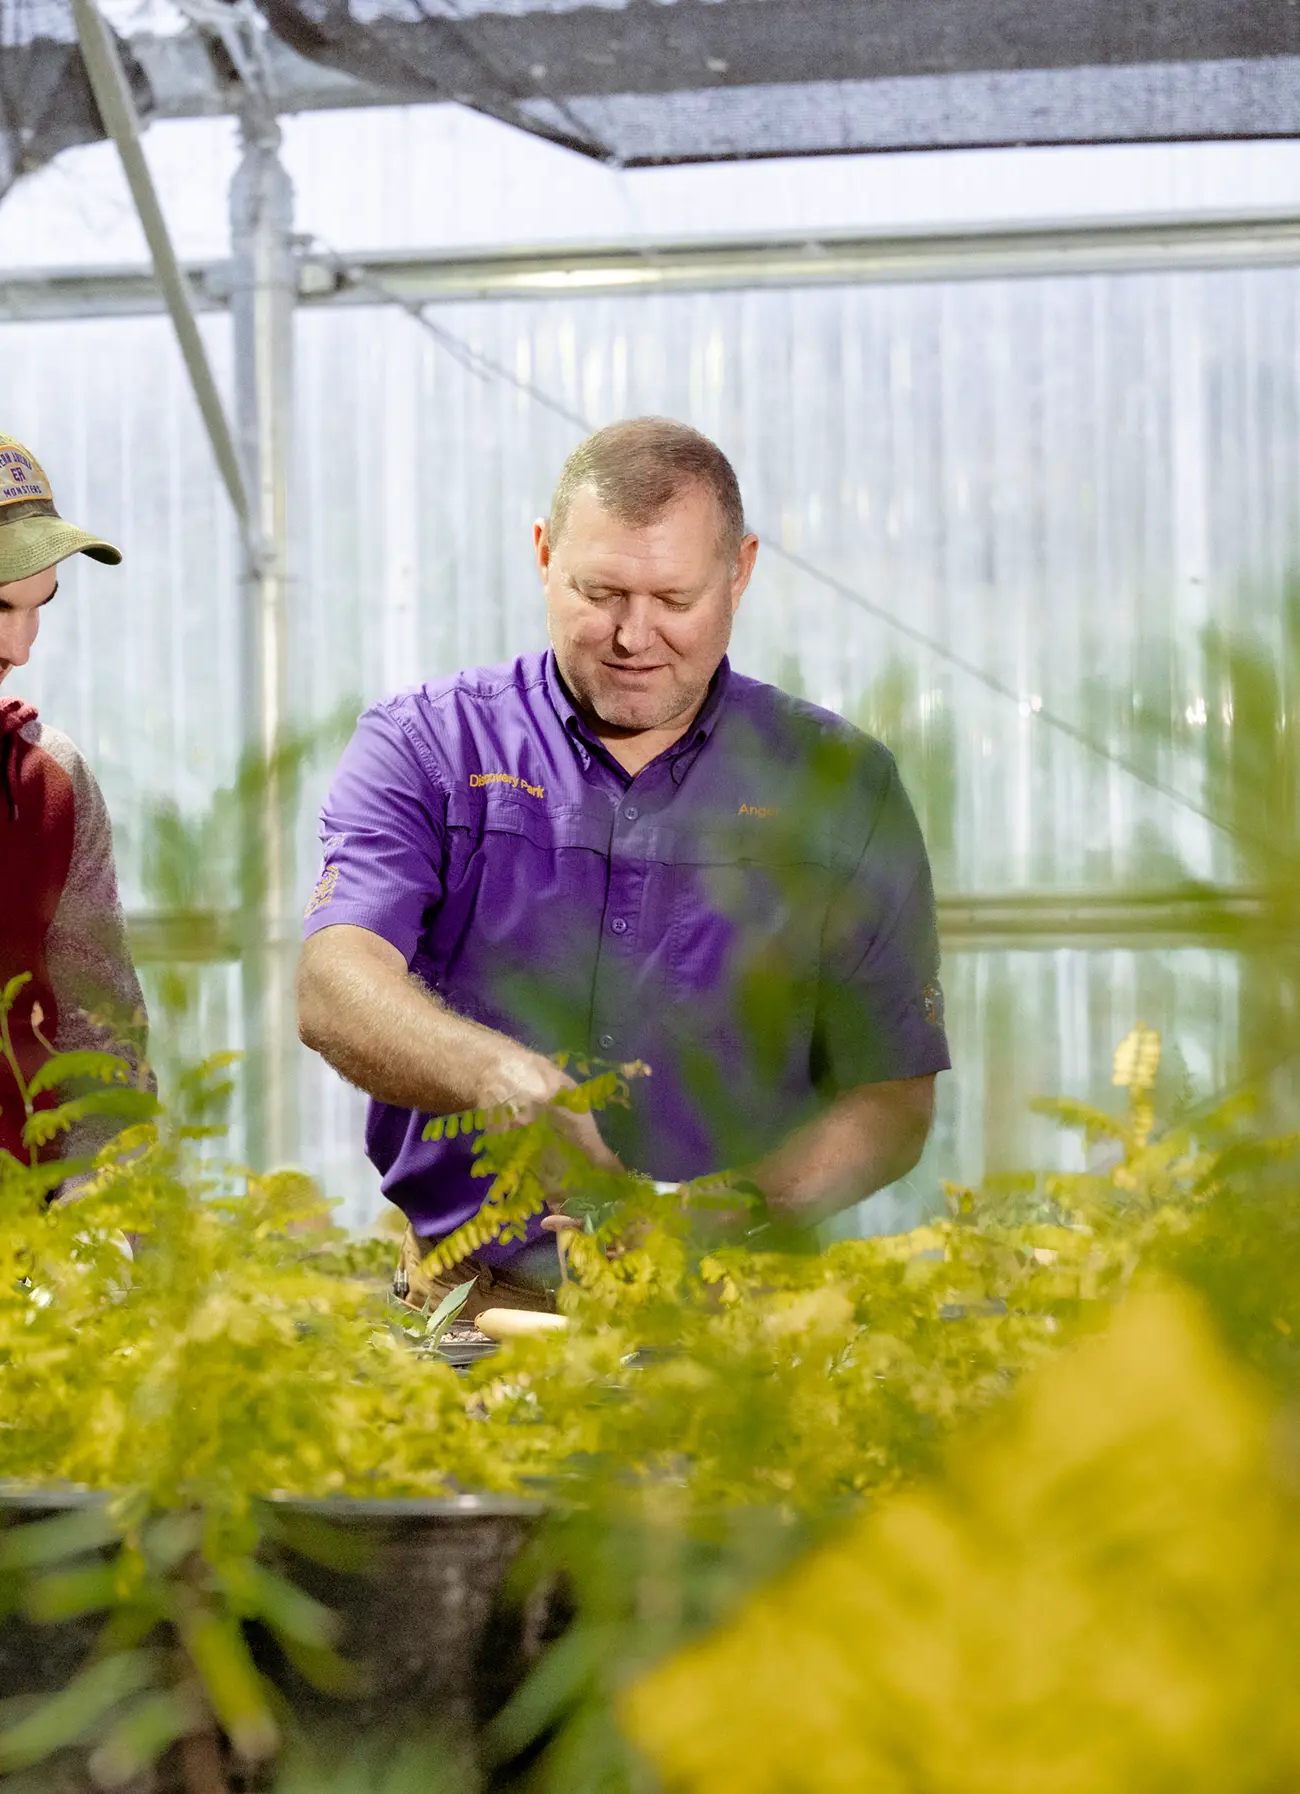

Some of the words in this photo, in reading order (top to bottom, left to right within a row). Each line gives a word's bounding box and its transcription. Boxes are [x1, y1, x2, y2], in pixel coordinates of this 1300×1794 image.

[3, 485, 42, 498] MONSTERS
[469, 773, 520, 788] Discovery
[520, 779, 545, 798] Park
